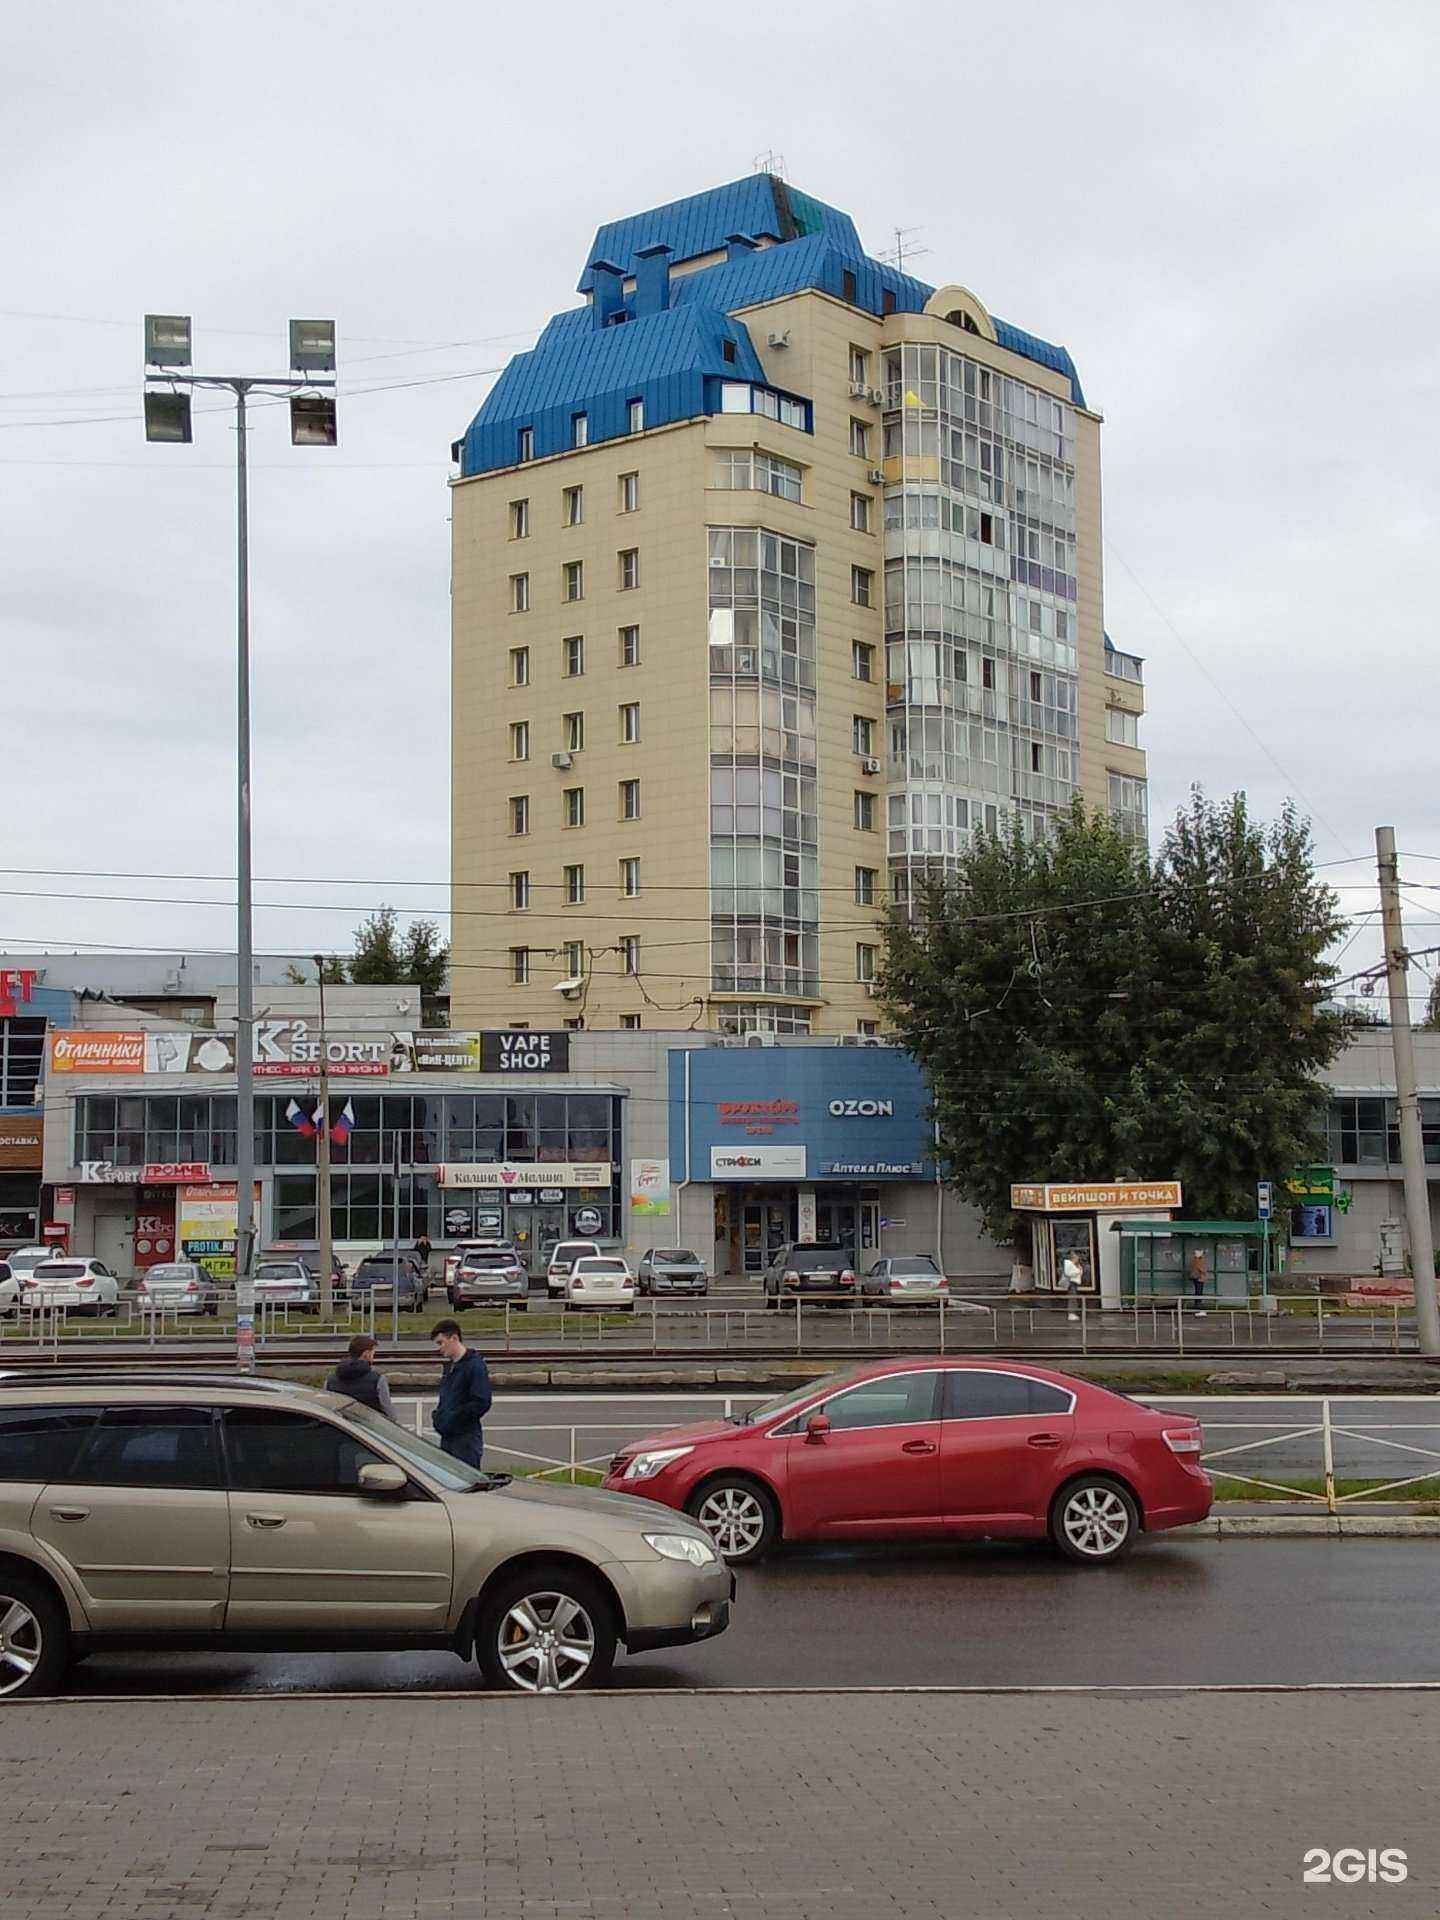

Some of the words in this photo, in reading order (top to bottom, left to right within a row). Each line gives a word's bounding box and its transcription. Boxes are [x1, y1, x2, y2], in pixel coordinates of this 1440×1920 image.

[500, 1035, 550, 1050] VAPE
[500, 1053, 550, 1069] SHOP
[829, 1100, 893, 1116] OZON
[1130, 1190, 1174, 1201] ТОЧКА
